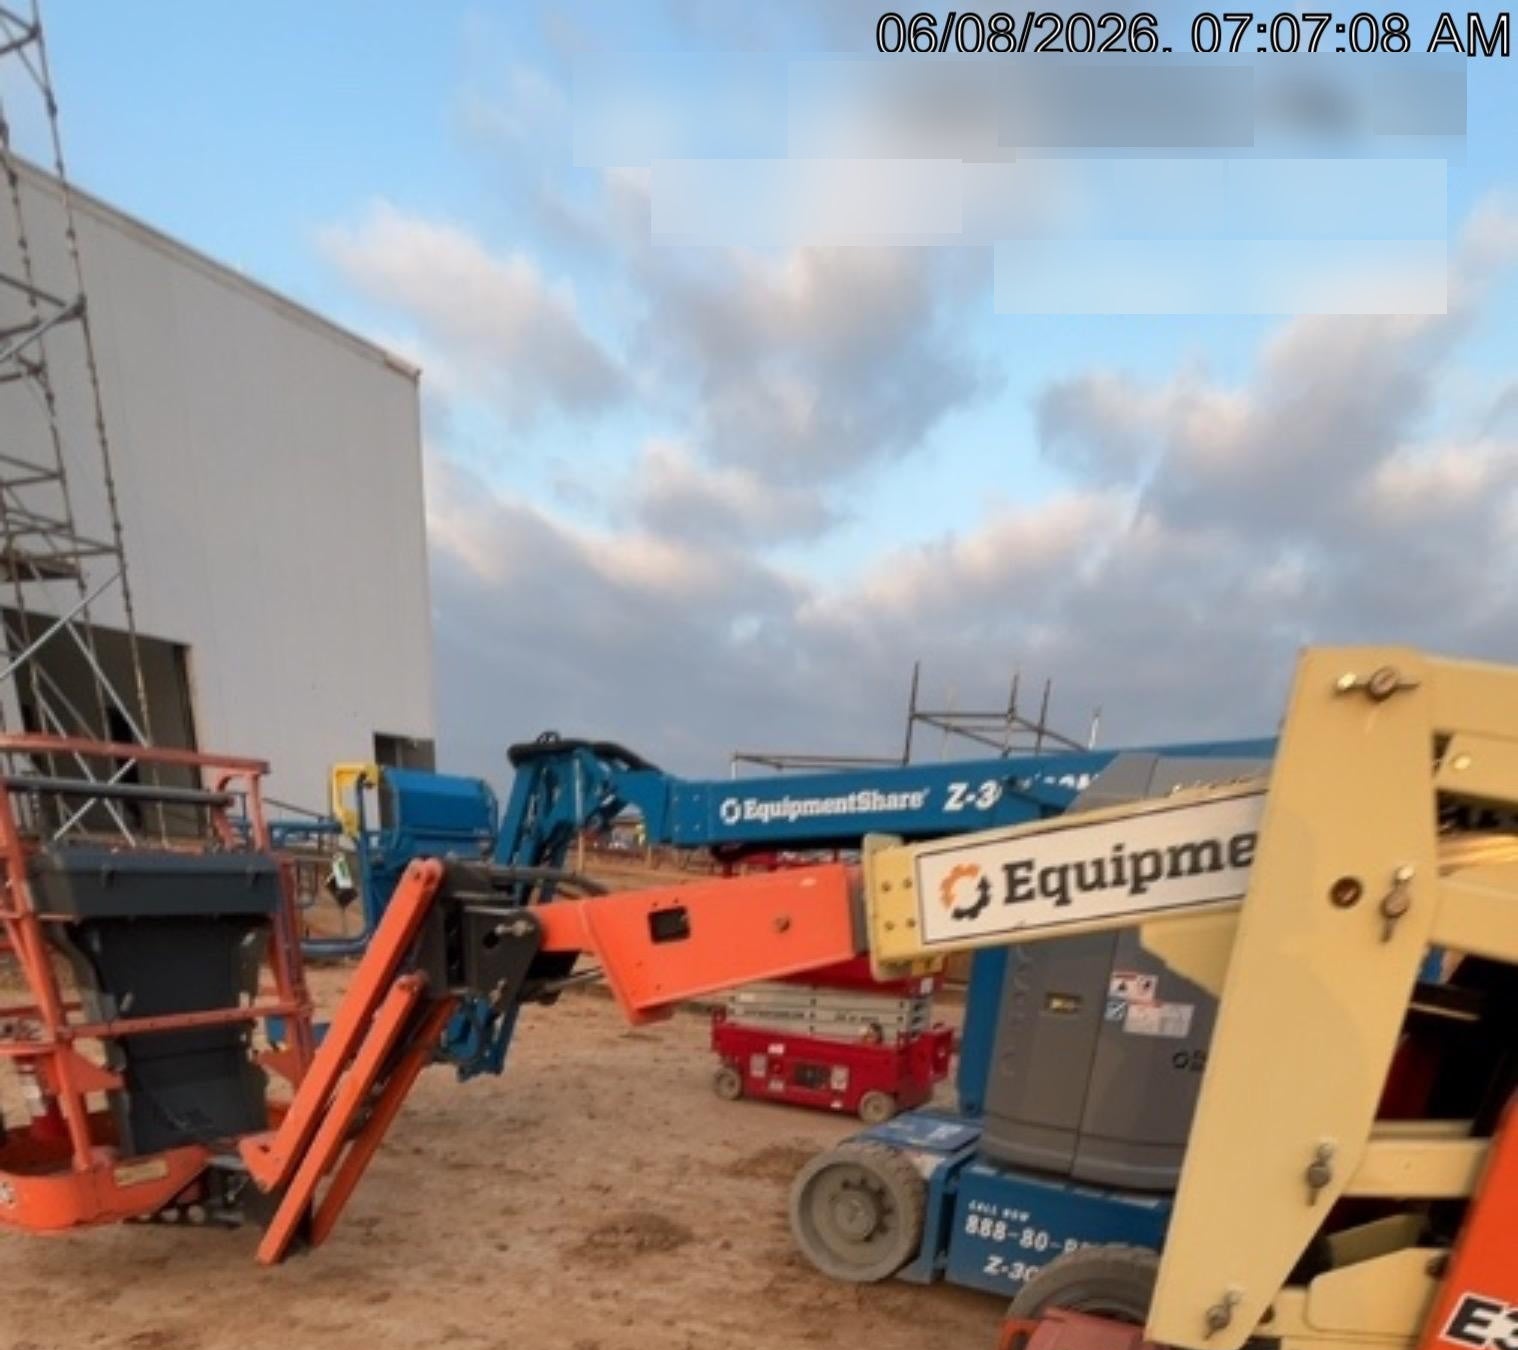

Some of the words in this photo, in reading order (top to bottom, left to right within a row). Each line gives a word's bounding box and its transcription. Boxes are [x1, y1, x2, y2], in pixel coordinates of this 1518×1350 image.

[743, 788, 925, 824] EquipmentShare
[943, 779, 1003, 811] Z-3
[1001, 831, 1259, 907] Equipme
